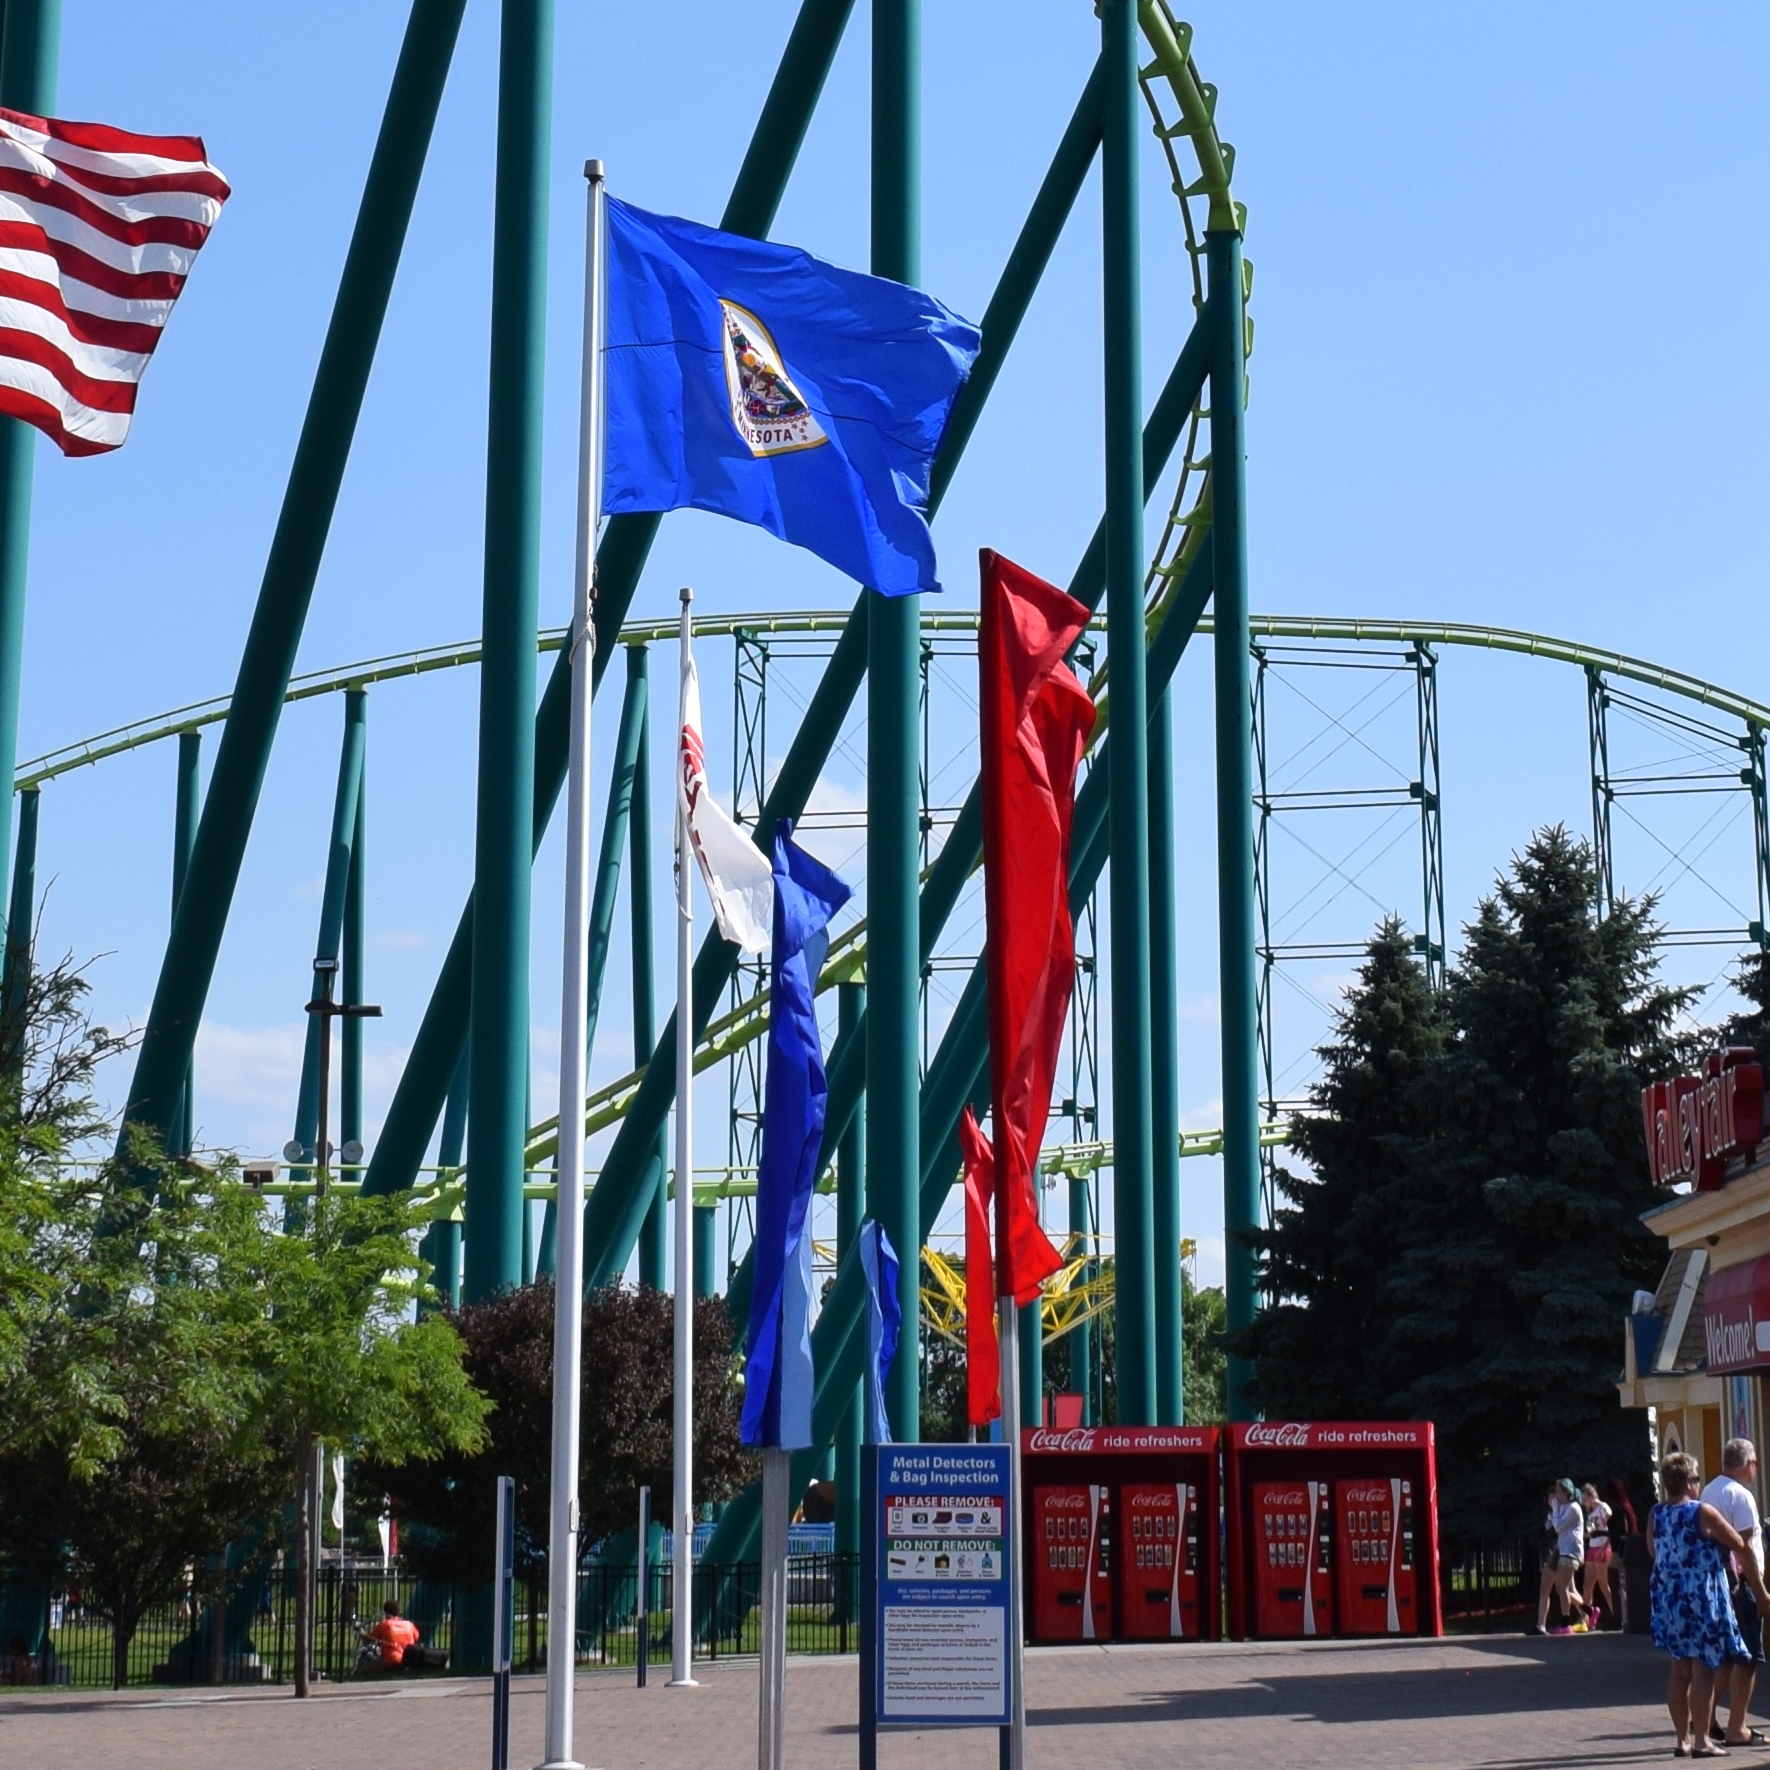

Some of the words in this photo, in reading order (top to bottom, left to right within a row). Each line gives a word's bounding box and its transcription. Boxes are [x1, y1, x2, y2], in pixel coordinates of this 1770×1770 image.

[1704, 1304, 1755, 1366] Welcome!
[1103, 1434, 1130, 1447] ride
[1134, 1434, 1202, 1447] refreshers
[1318, 1430, 1345, 1442] ride
[1348, 1429, 1417, 1443] refreshers
[893, 1456, 930, 1469] Metal
[933, 1456, 996, 1469] Detectors
[890, 1470, 900, 1483] &
[902, 1471, 928, 1486] Bag
[930, 1471, 999, 1486] Inspection
[894, 1496, 938, 1507] PLEASE
[893, 1540, 912, 1550] DO
[914, 1540, 940, 1550] NOT
